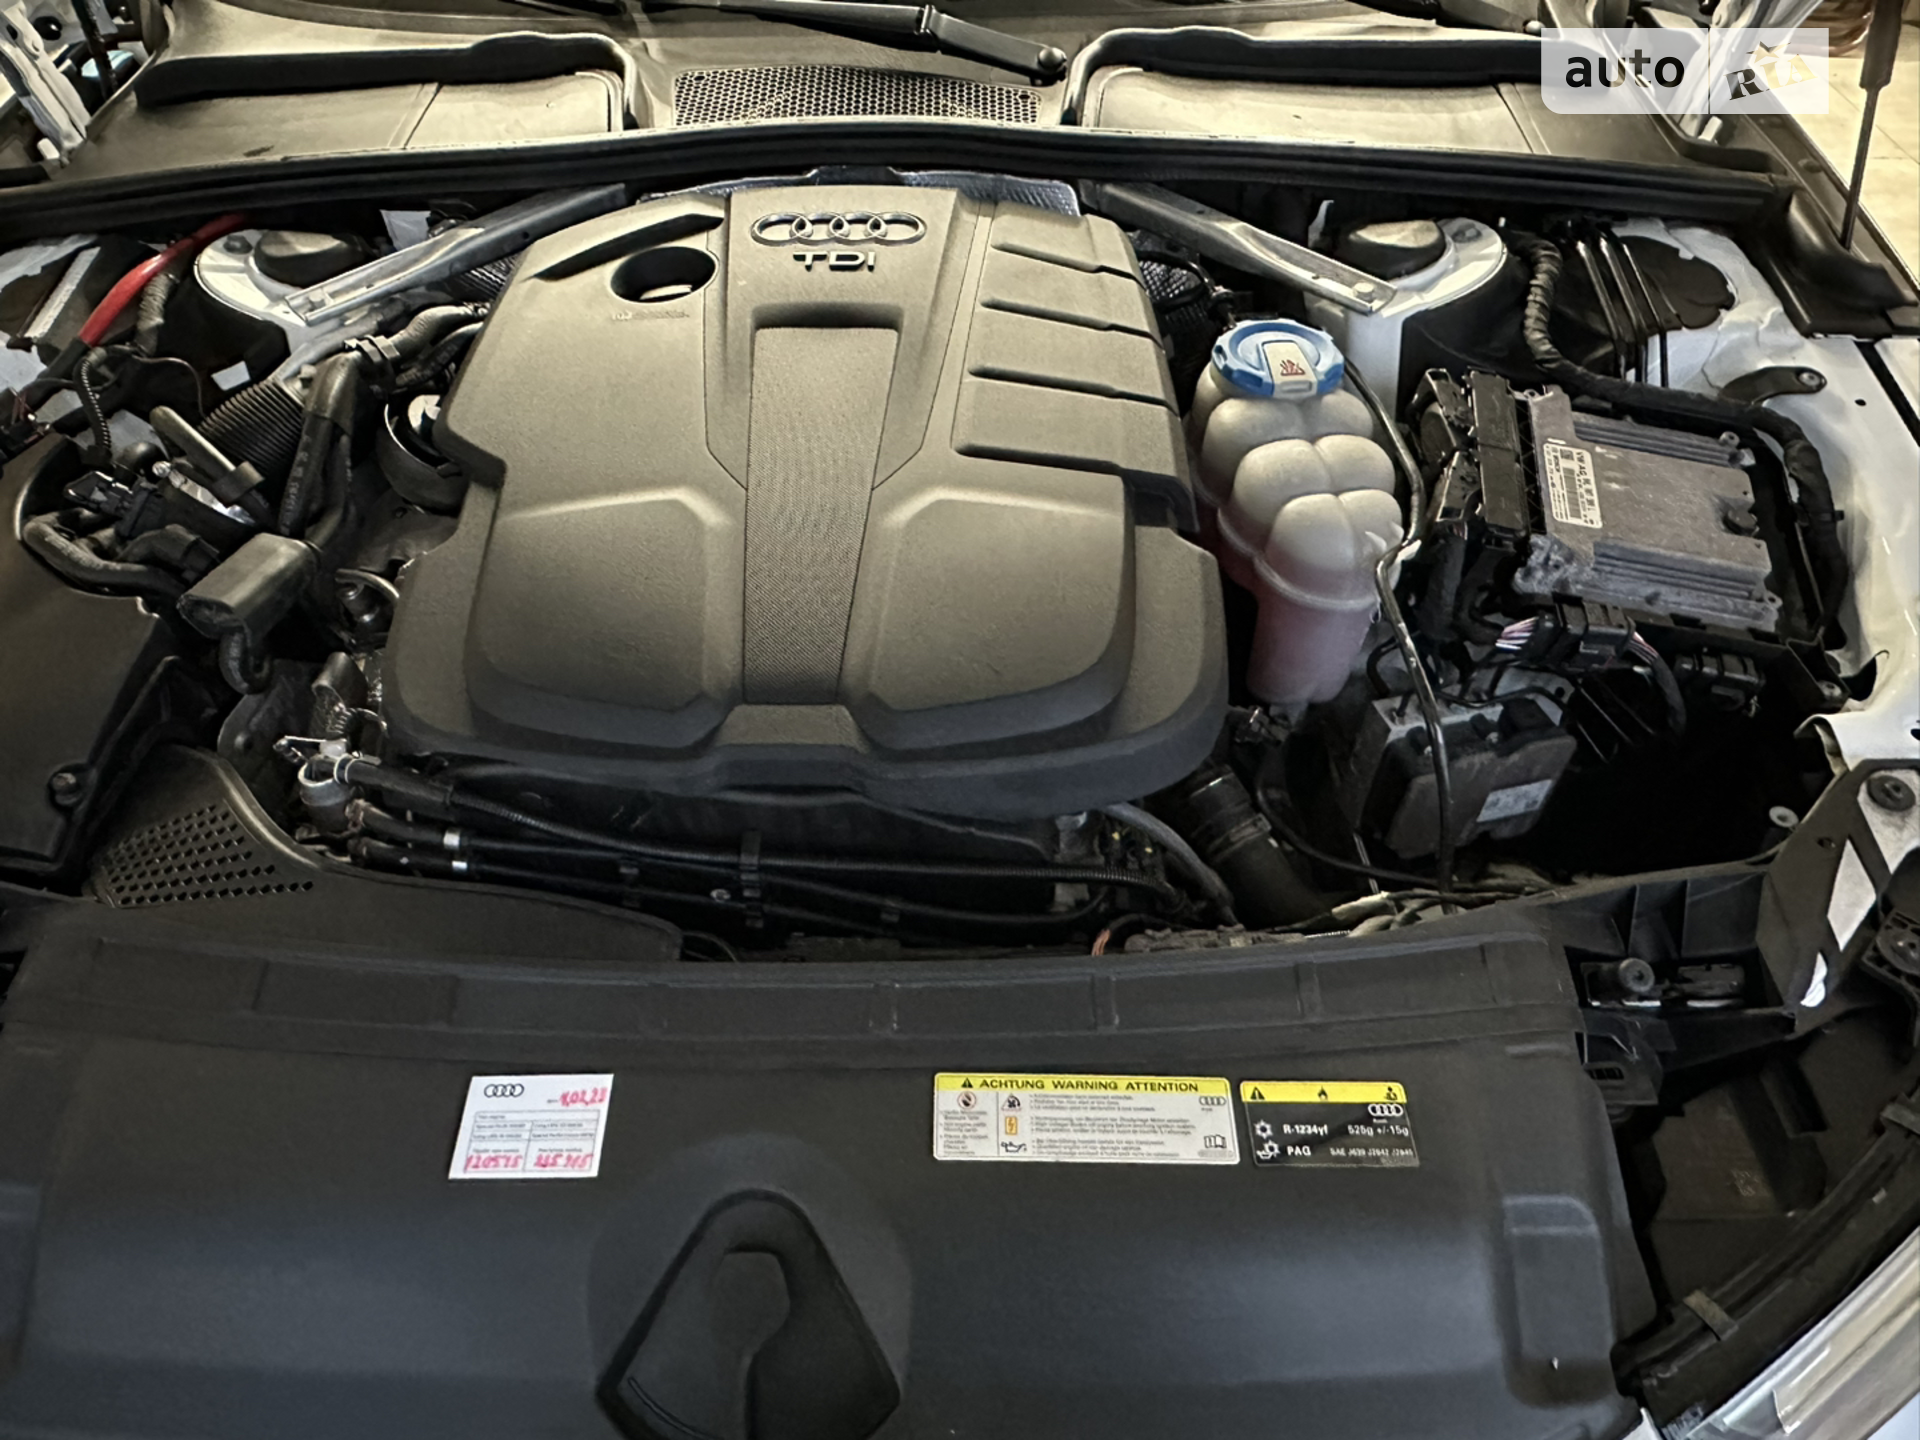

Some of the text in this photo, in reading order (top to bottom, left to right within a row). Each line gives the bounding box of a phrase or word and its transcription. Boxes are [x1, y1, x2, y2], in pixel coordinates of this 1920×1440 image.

[792, 251, 876, 272] TDI
[979, 1079, 1199, 1092] ACHTUNG WARNING ATTENTION
[1287, 1145, 1312, 1156] PAG
